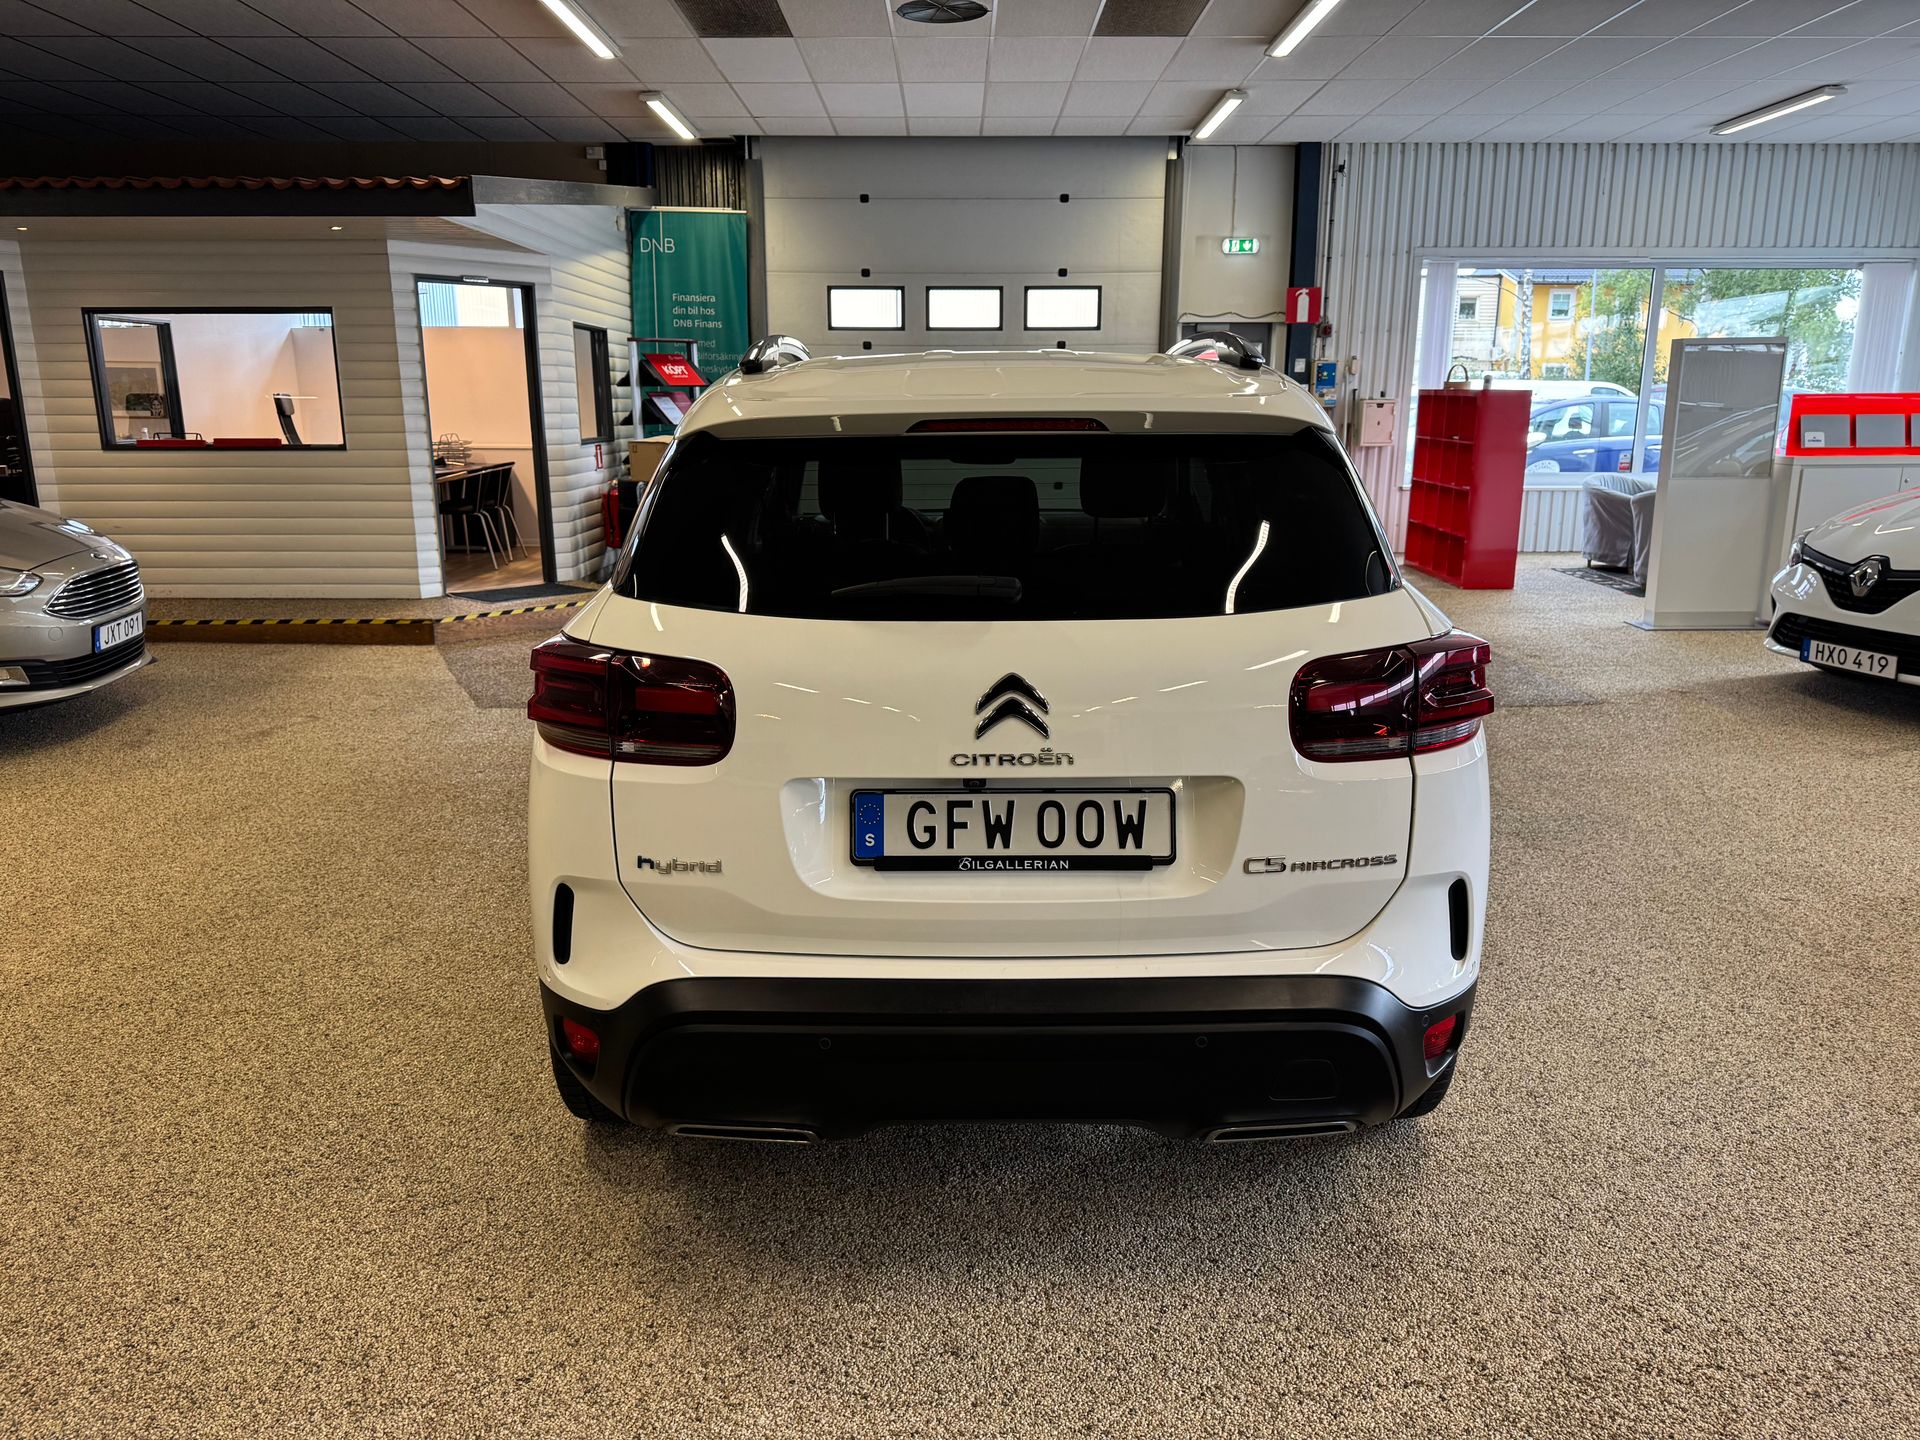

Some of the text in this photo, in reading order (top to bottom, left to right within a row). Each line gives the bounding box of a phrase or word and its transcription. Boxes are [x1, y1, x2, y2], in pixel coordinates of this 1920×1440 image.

[639, 237, 676, 254] DNB
[672, 292, 716, 303] Finansiera
[672, 305, 716, 316] din bil hos
[673, 318, 723, 330] DNB Finans
[698, 340, 716, 348] med
[104, 615, 140, 645] JXT 091
[1815, 643, 1889, 673] HXO 419
[864, 799, 1148, 850] S GFW 00W
[637, 855, 722, 875] hybrid
[957, 857, 1069, 871] BILGALLERIAN
[1243, 853, 1398, 875] C5 AIRCROSS
